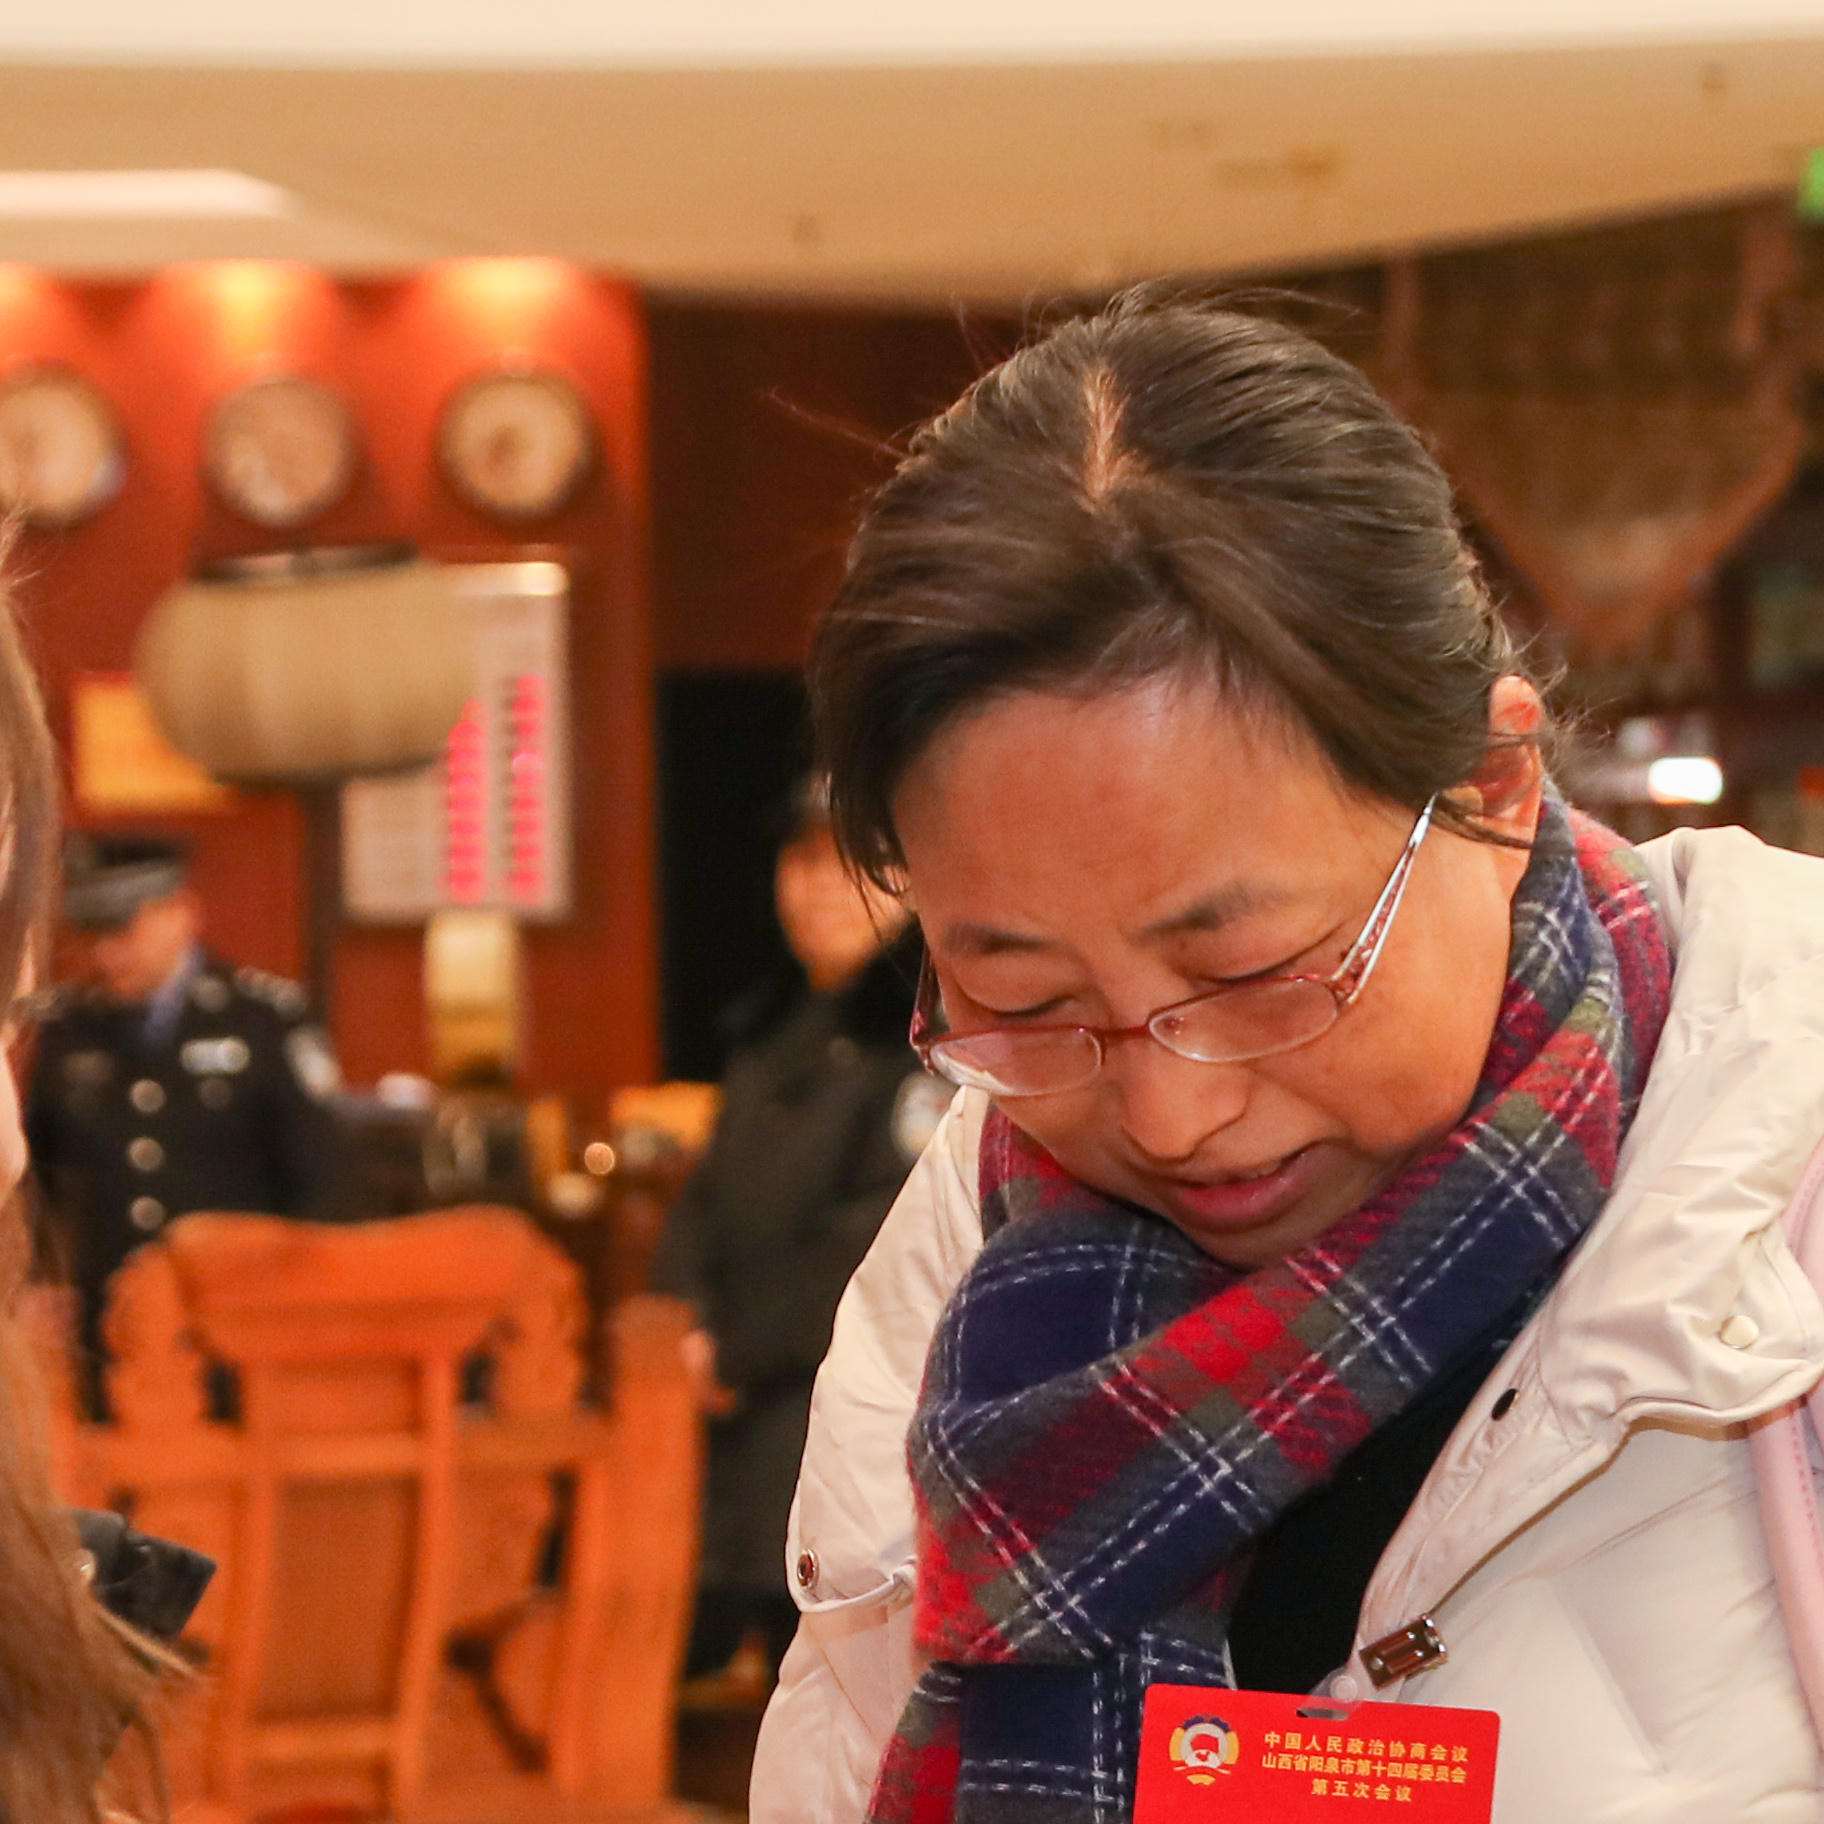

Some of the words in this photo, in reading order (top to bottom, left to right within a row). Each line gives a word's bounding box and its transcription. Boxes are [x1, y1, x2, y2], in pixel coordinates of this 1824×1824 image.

[1264, 1731, 1469, 1762] 中国人民政治协商会议
[1261, 1752, 1467, 1783] 山西省阳泉市第十四届委员会
[1311, 1778, 1413, 1802] 第五次会议
